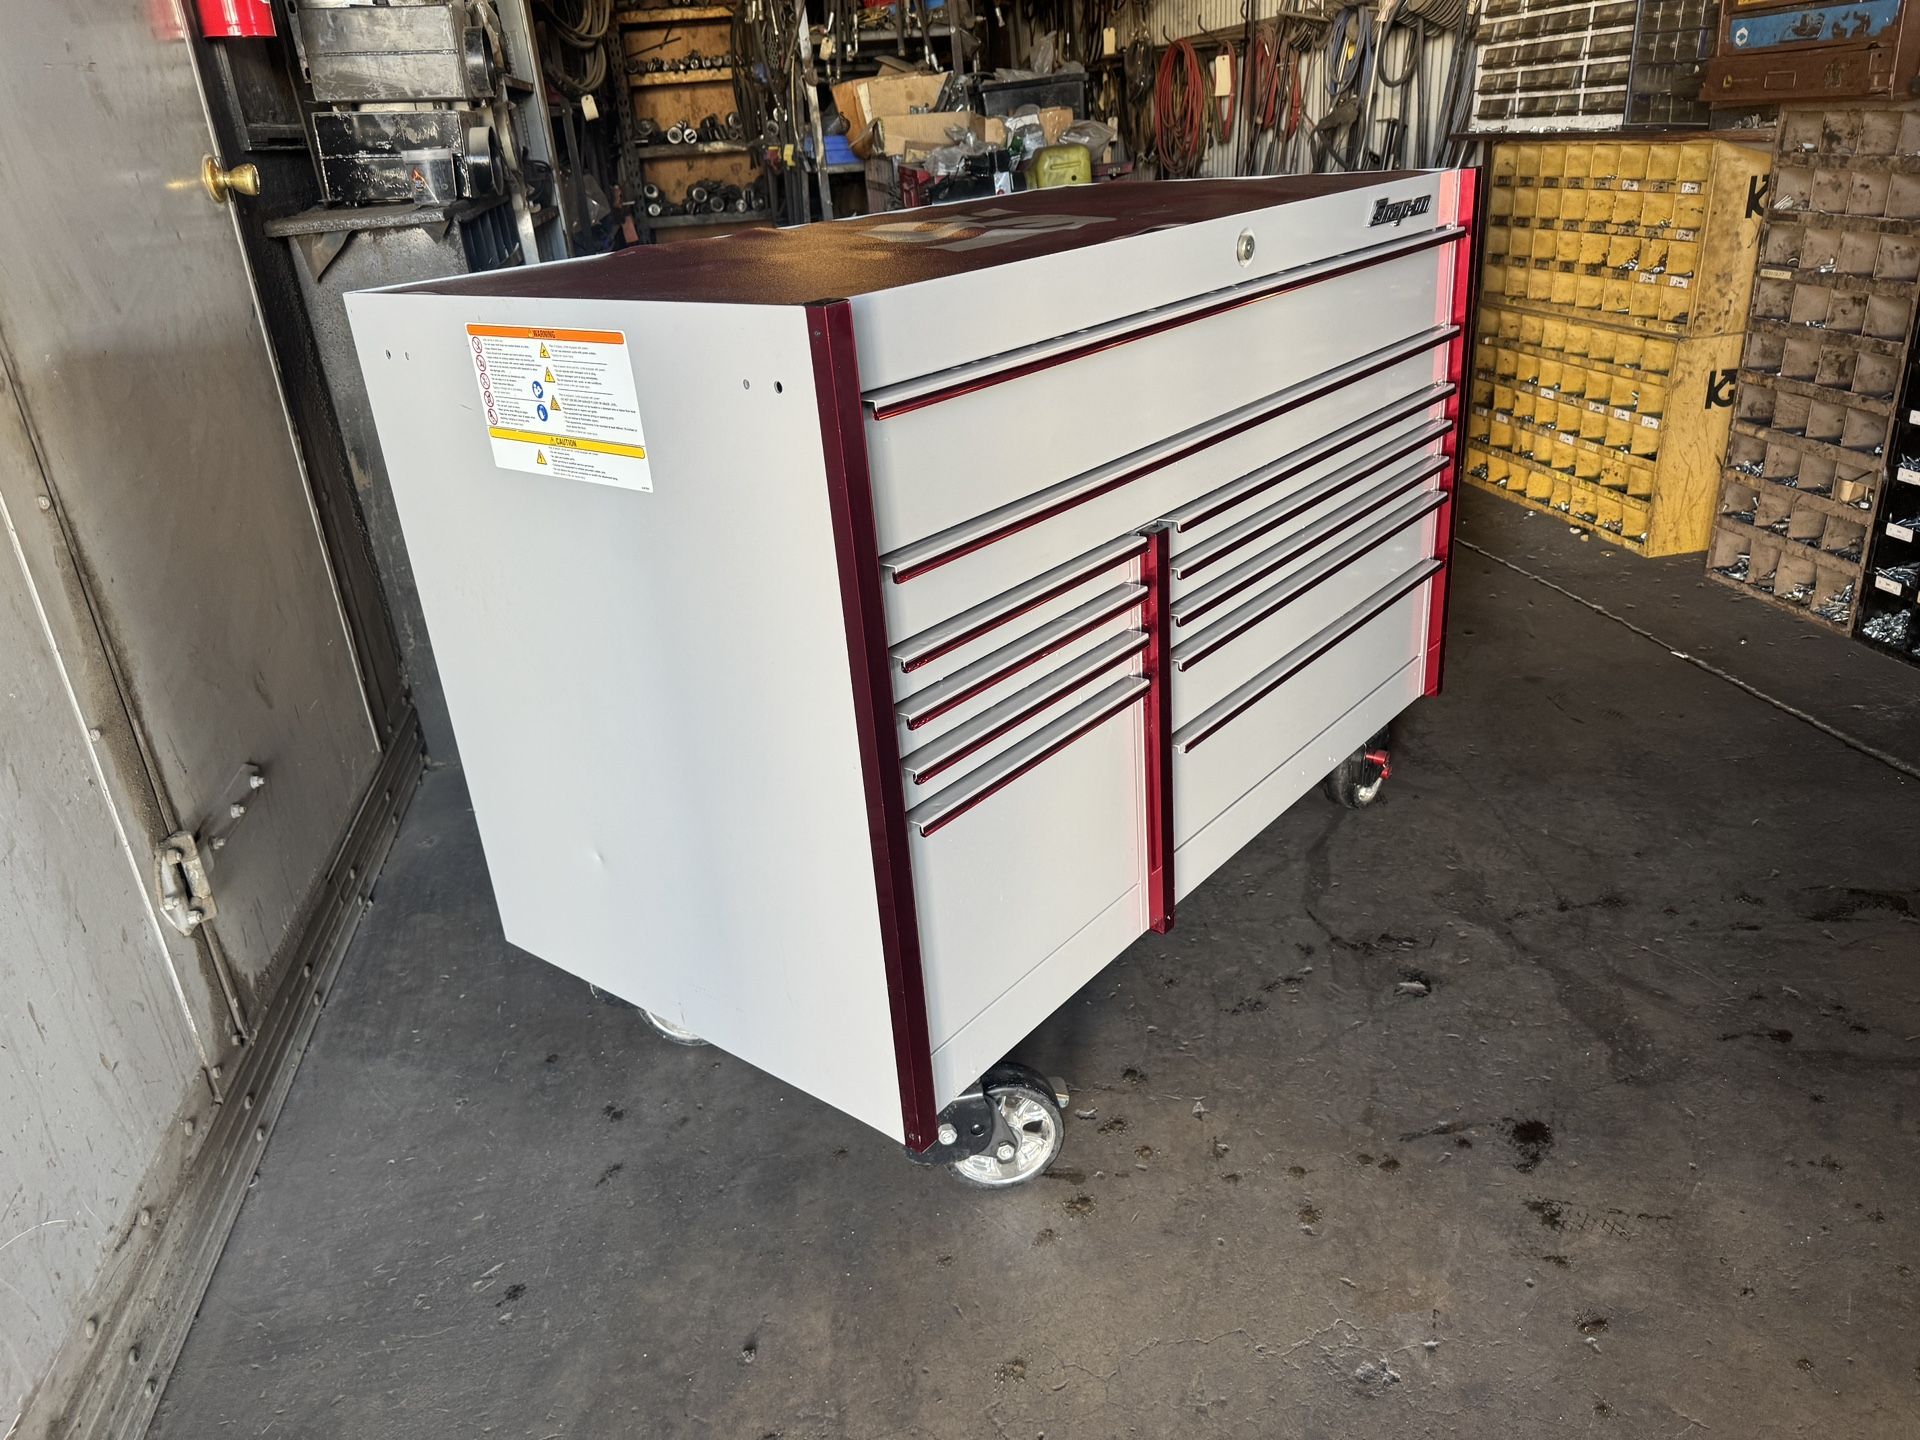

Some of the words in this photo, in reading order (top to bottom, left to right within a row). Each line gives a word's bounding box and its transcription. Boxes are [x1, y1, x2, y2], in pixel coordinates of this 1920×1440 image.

[1744, 174, 1770, 219] K
[1369, 194, 1431, 227] Snap-on
[532, 329, 556, 339] WARNING
[555, 437, 577, 448] CAUTION
